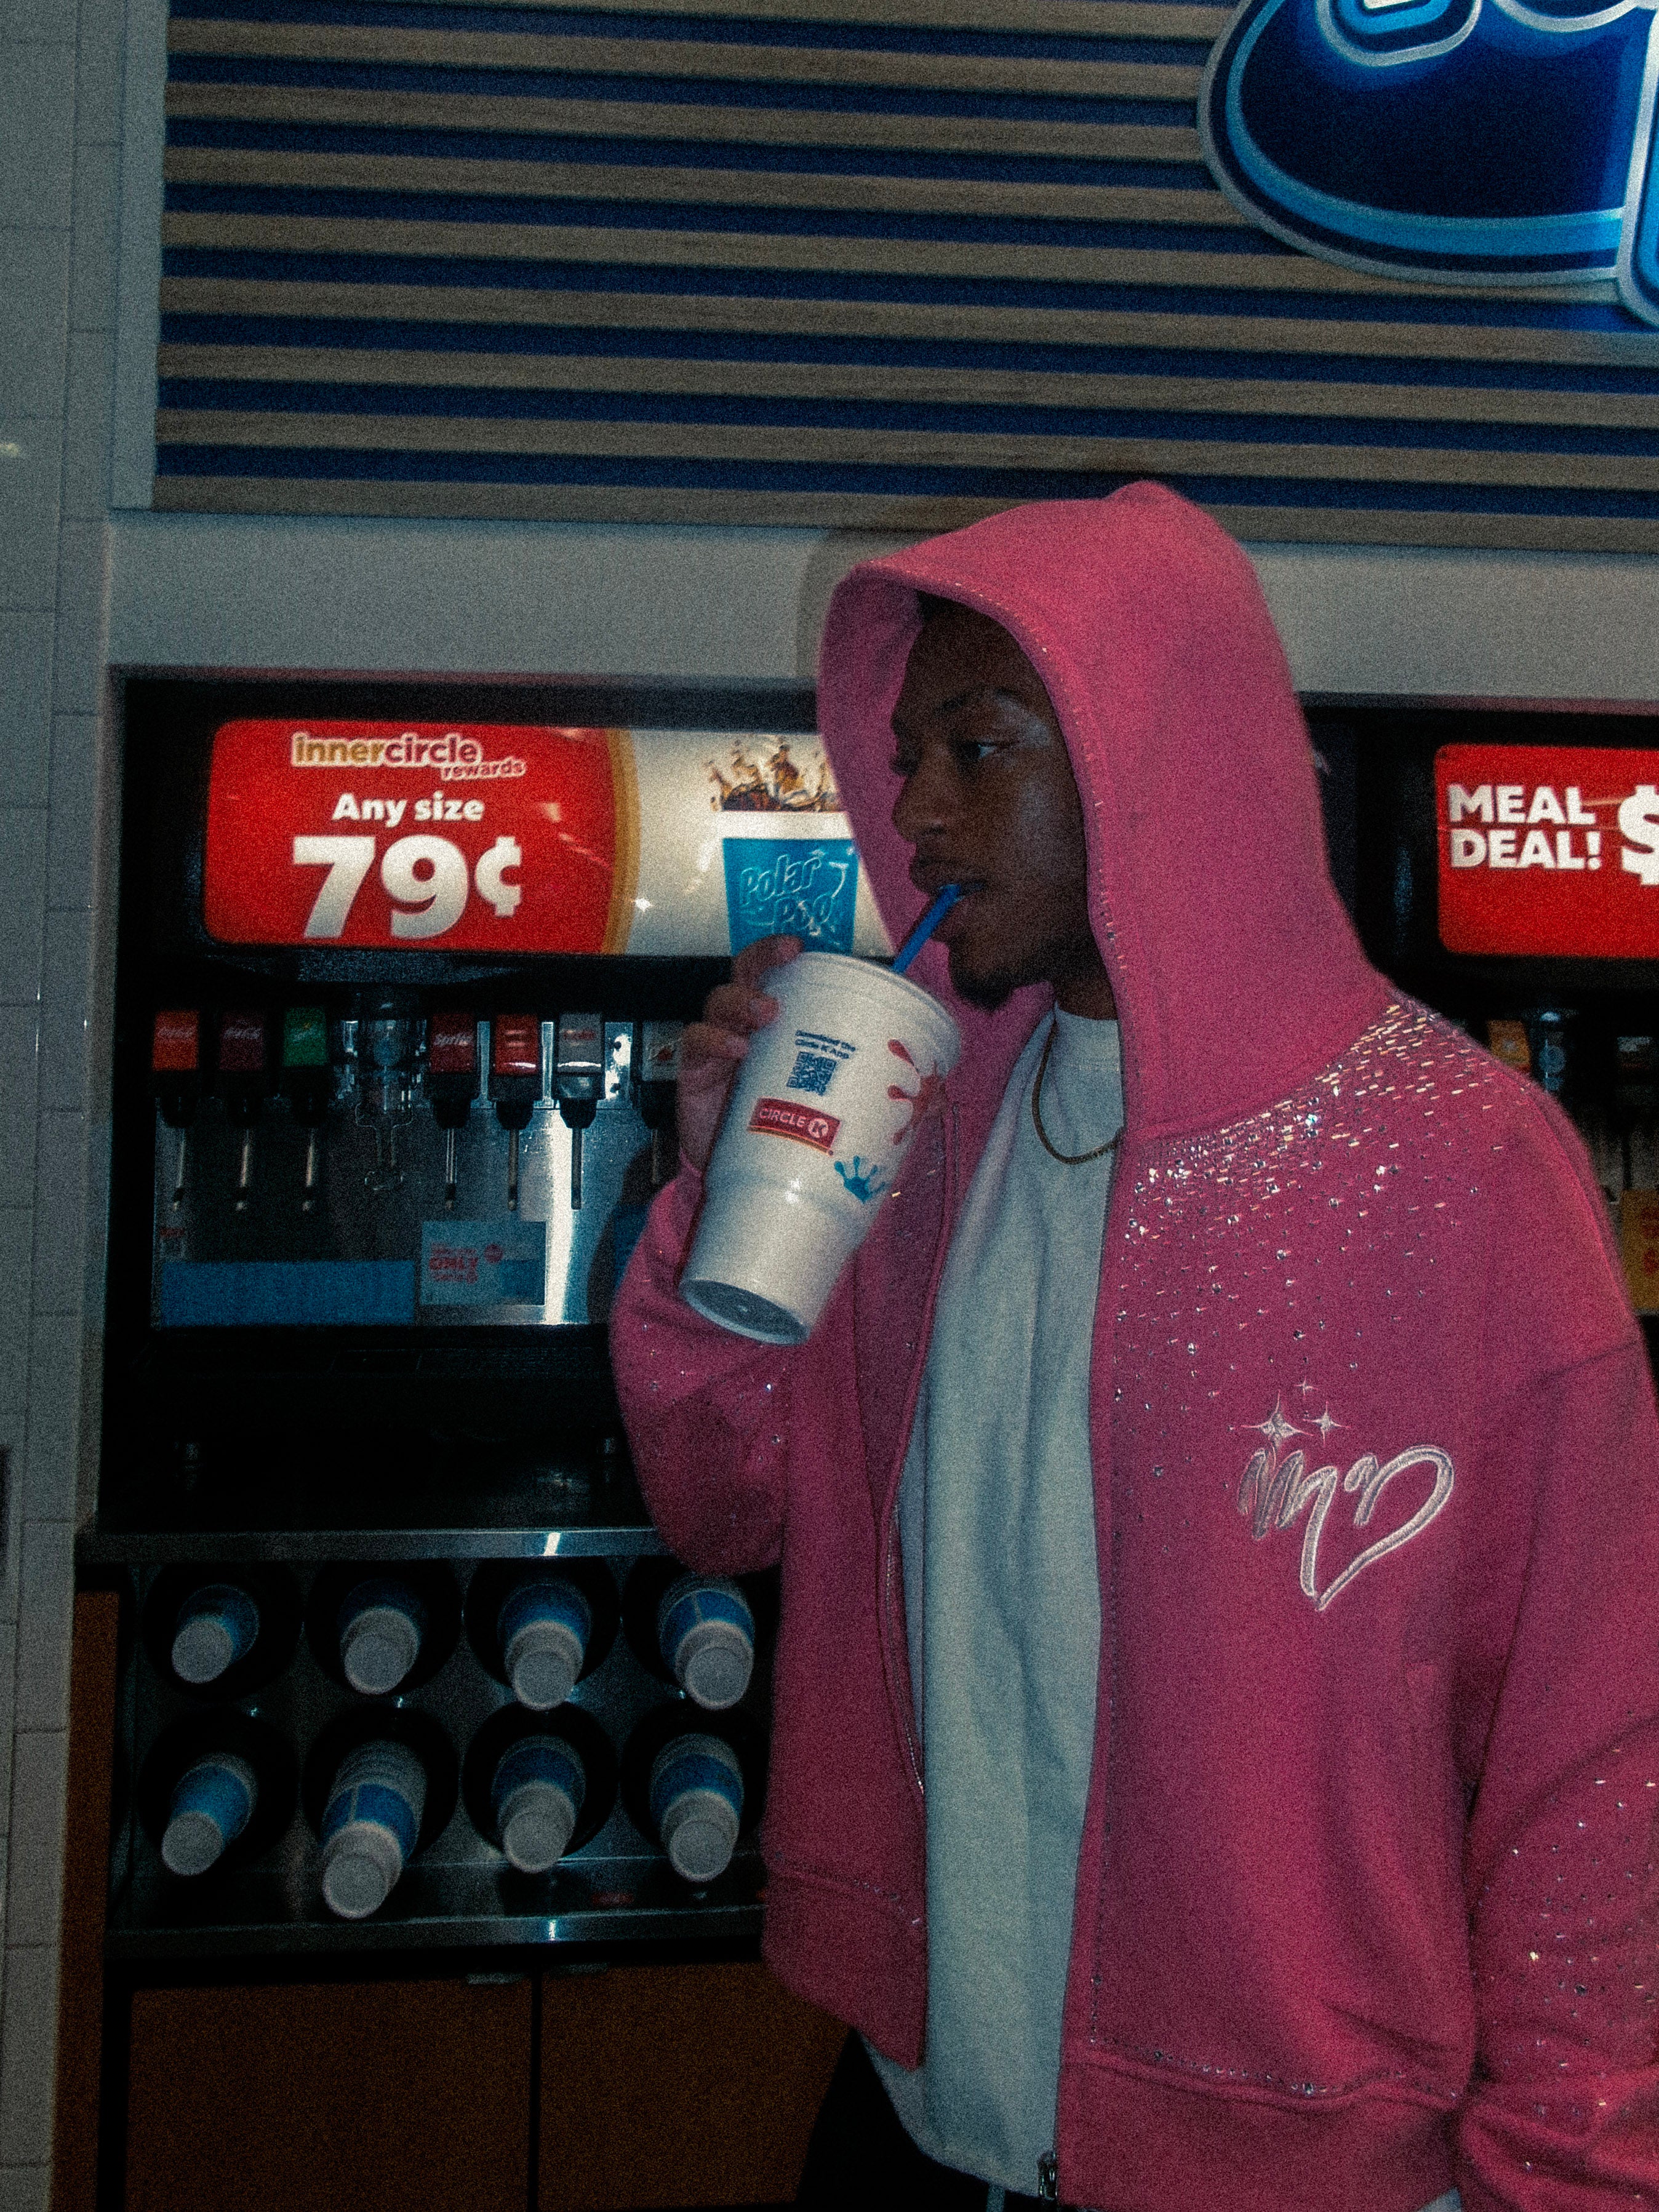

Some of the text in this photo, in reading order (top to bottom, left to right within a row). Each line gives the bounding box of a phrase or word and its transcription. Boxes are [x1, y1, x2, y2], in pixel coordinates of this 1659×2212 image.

[442, 758, 525, 780] rewards
[332, 790, 485, 828] Any size
[1448, 783, 1596, 825] MEAL
[1450, 828, 1601, 871] DEAL!
[292, 834, 522, 940] 79¢
[739, 854, 822, 907] Polar
[830, 1048, 849, 1060] App
[841, 1042, 856, 1052] the
[759, 1108, 828, 1138] CIRCLE K
